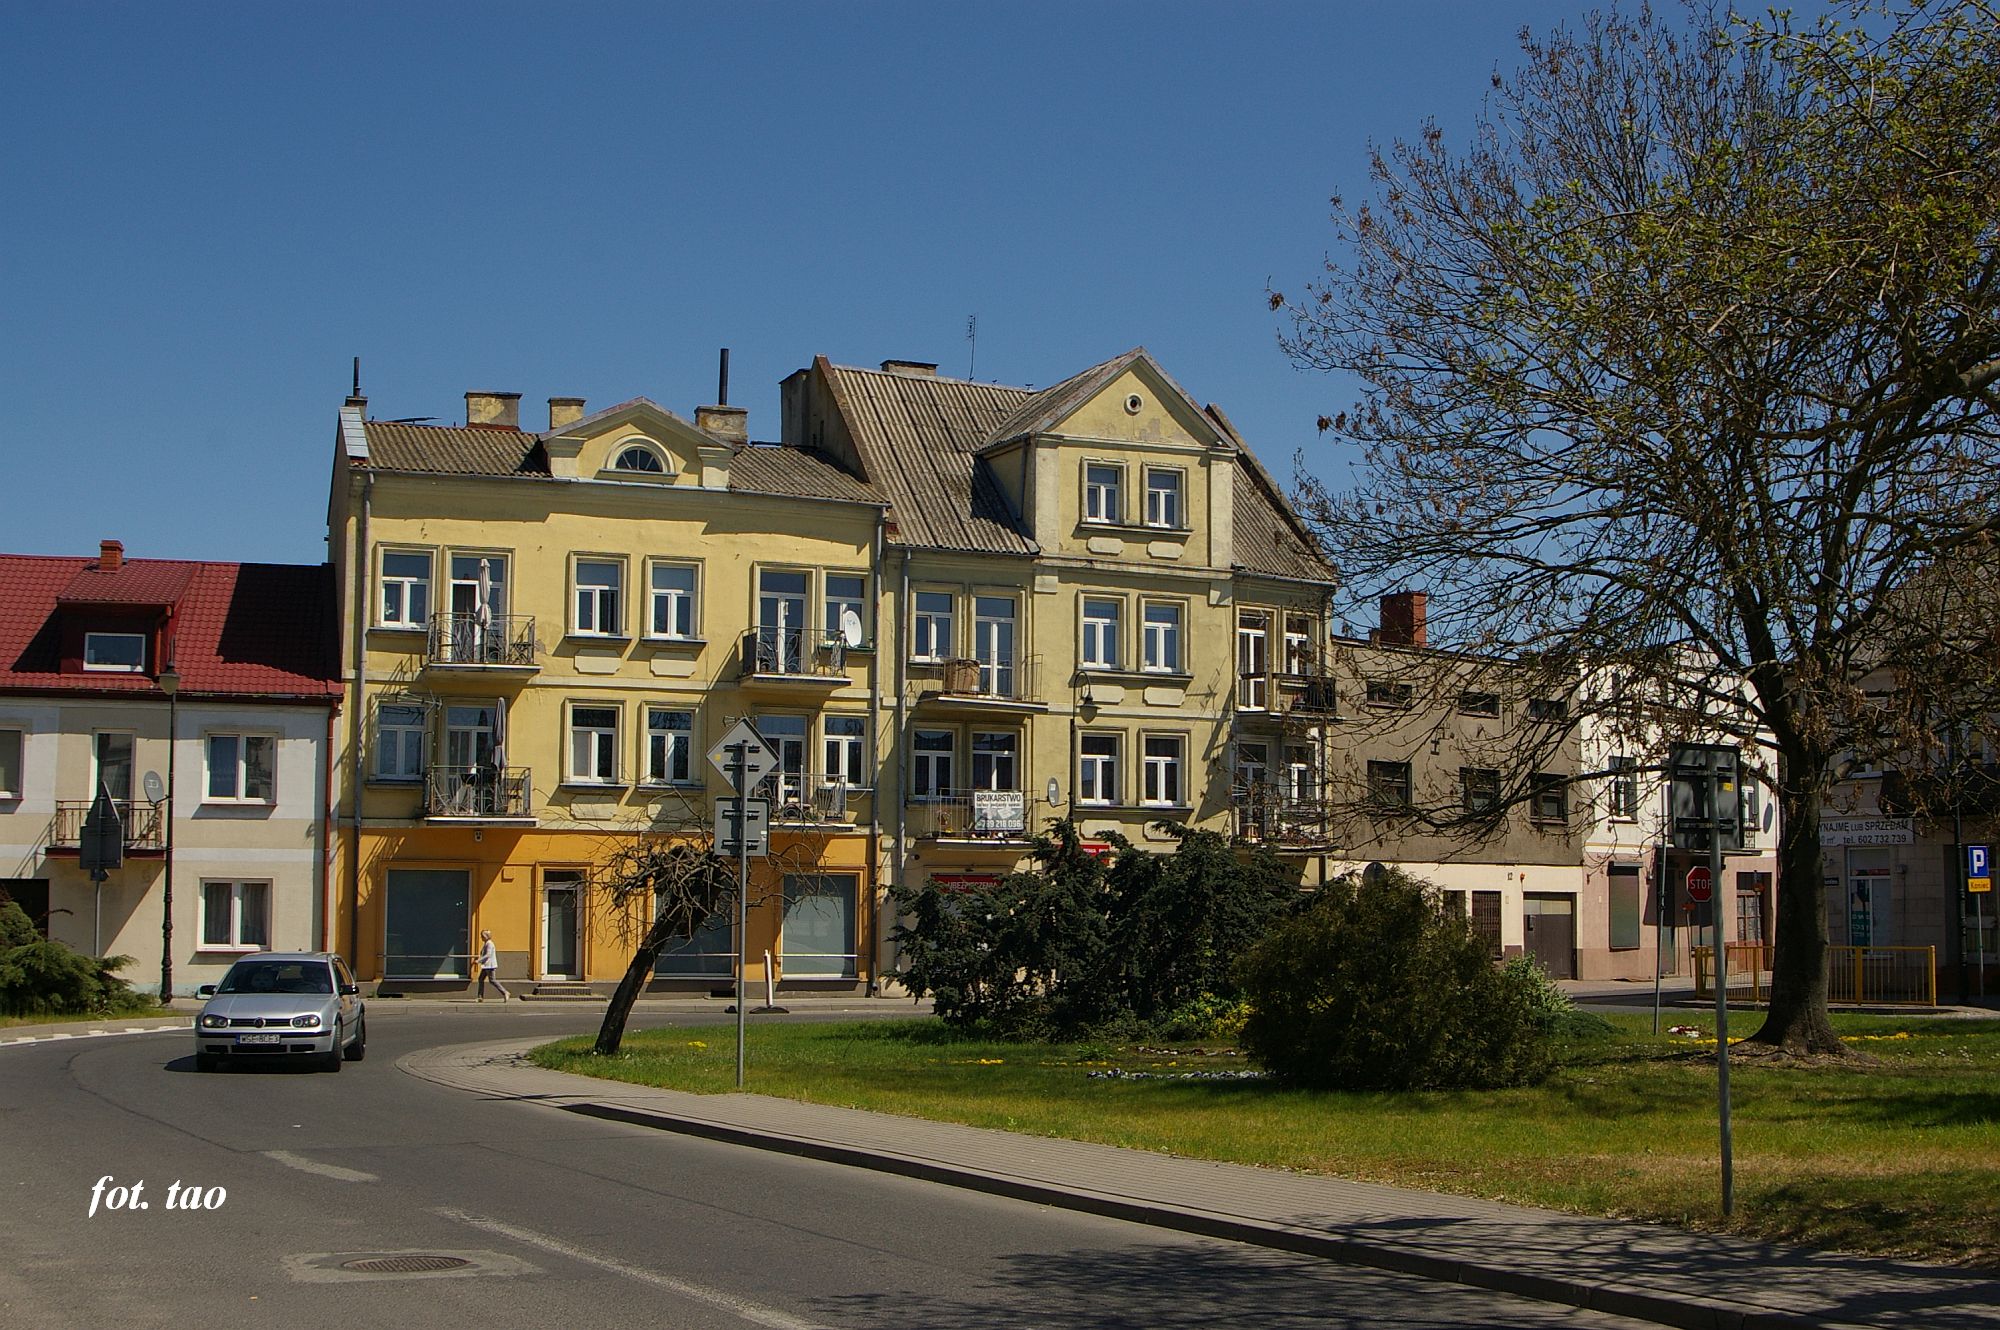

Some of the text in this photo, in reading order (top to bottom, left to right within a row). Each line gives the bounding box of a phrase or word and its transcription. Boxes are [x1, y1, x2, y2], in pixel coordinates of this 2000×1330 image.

[1819, 822, 1849, 833] YNAJMĘ
[1851, 823, 1863, 831] LUB
[1858, 836, 1872, 844] 602
[1875, 835, 1889, 843] 732
[1892, 834, 1906, 843] 739
[1973, 850, 1984, 873] P
[1690, 879, 1712, 889] STOP
